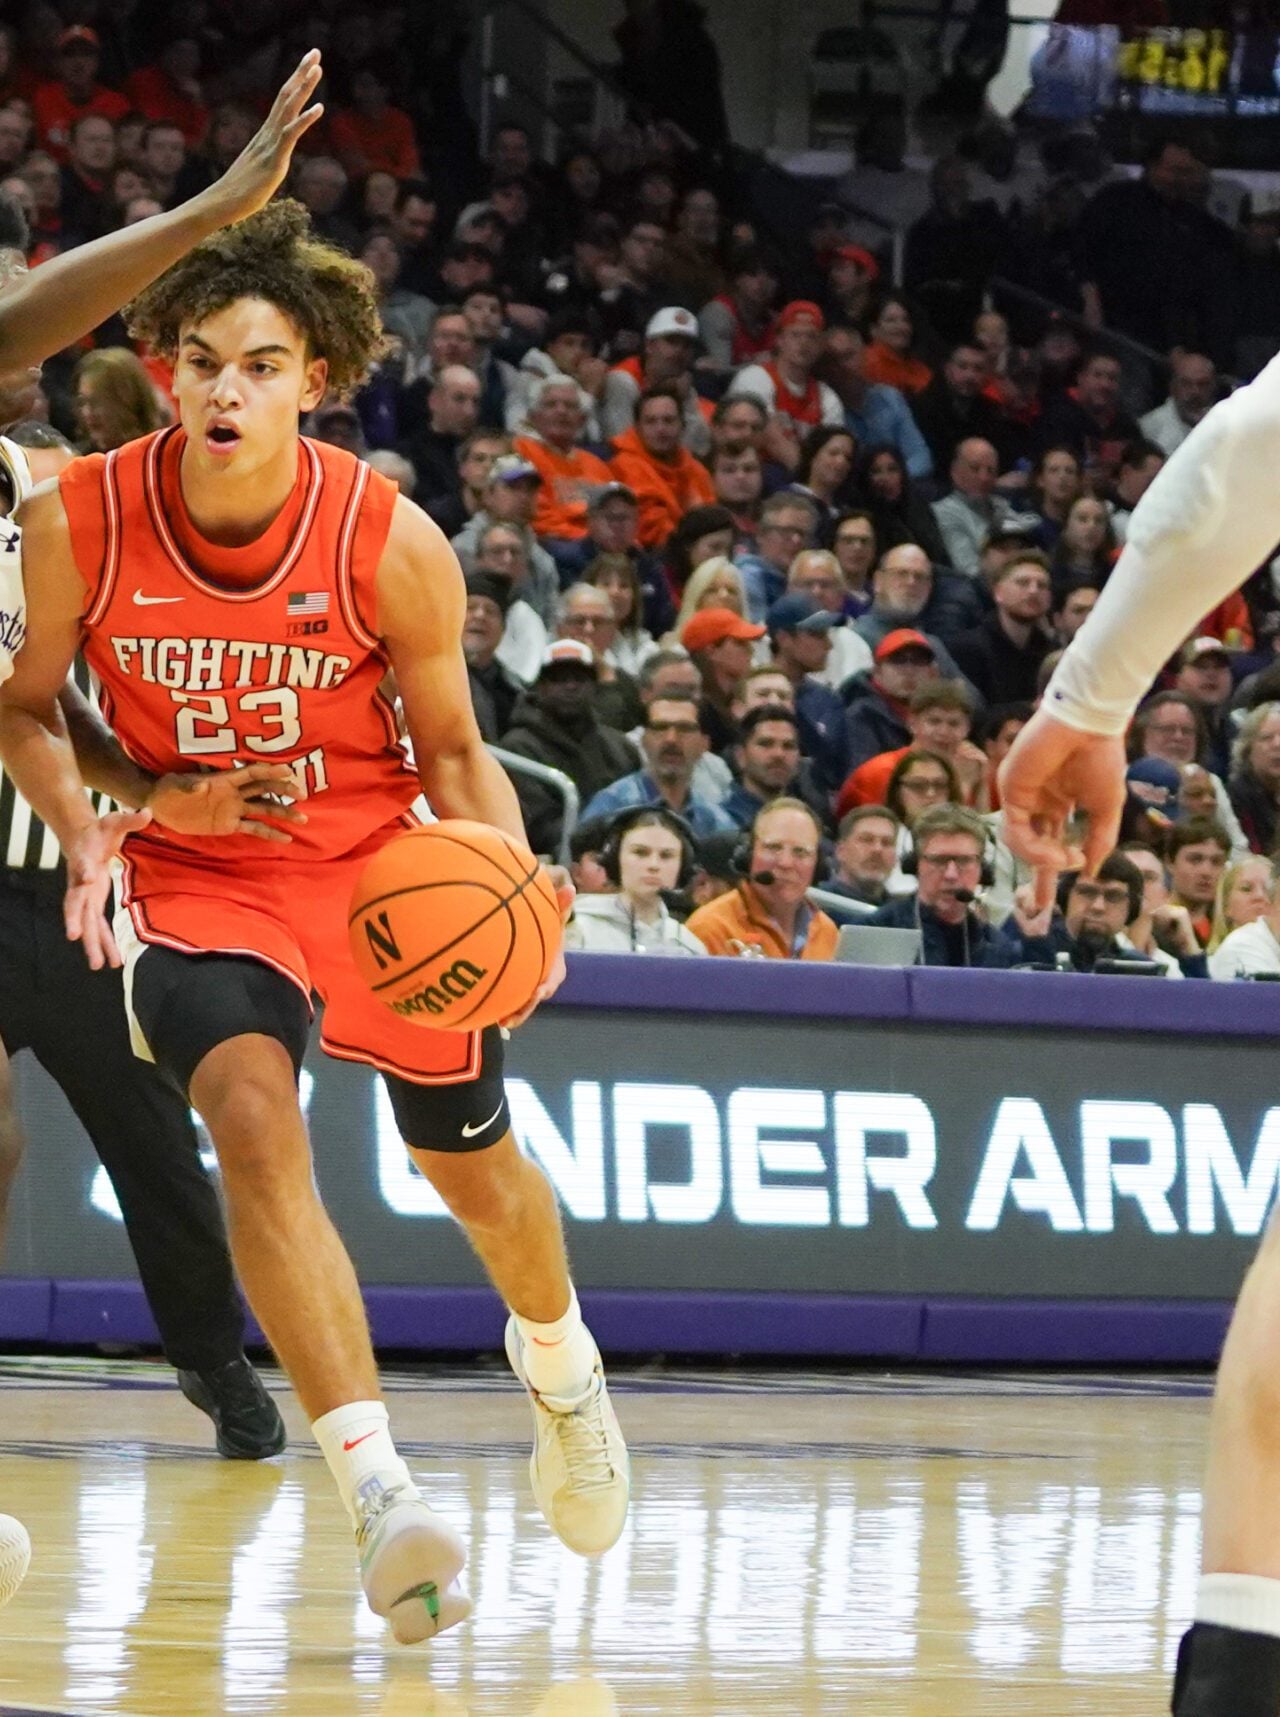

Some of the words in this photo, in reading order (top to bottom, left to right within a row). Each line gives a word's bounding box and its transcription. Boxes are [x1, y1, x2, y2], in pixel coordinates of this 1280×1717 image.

[110, 635, 352, 692] FIGHTING
[170, 686, 302, 755] 23
[364, 910, 402, 970] N
[965, 1096, 1280, 1235] ARM
